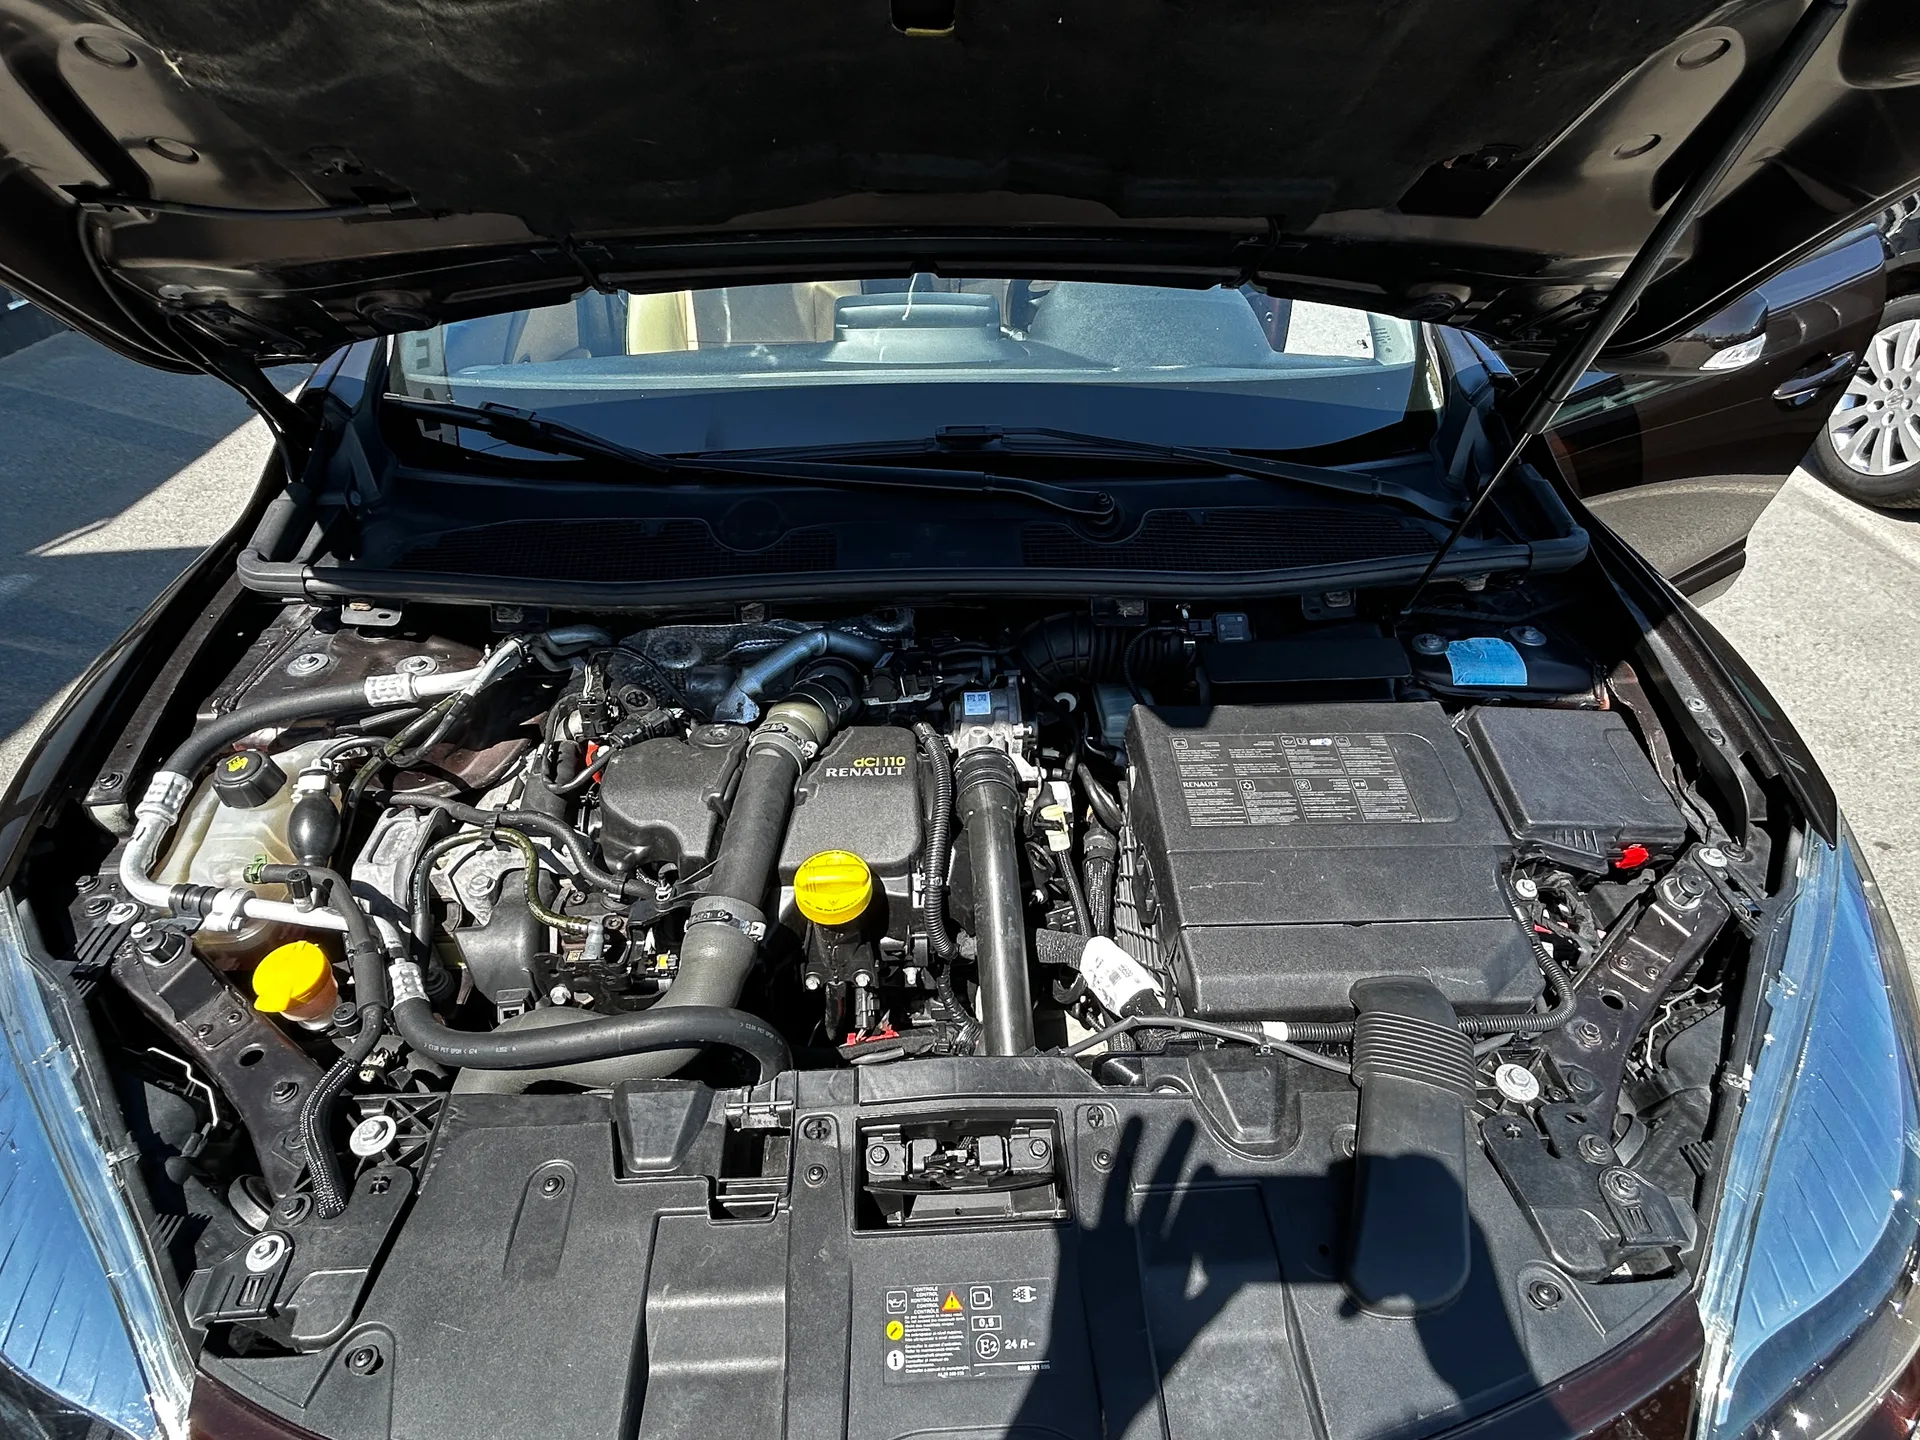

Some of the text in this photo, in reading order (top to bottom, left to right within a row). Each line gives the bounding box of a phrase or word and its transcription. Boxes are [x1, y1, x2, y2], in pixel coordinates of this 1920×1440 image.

[883, 756, 906, 767] 110
[826, 766, 906, 777] RENAULT
[980, 1339, 998, 1354] E2
[1004, 1338, 1018, 1350] 24
